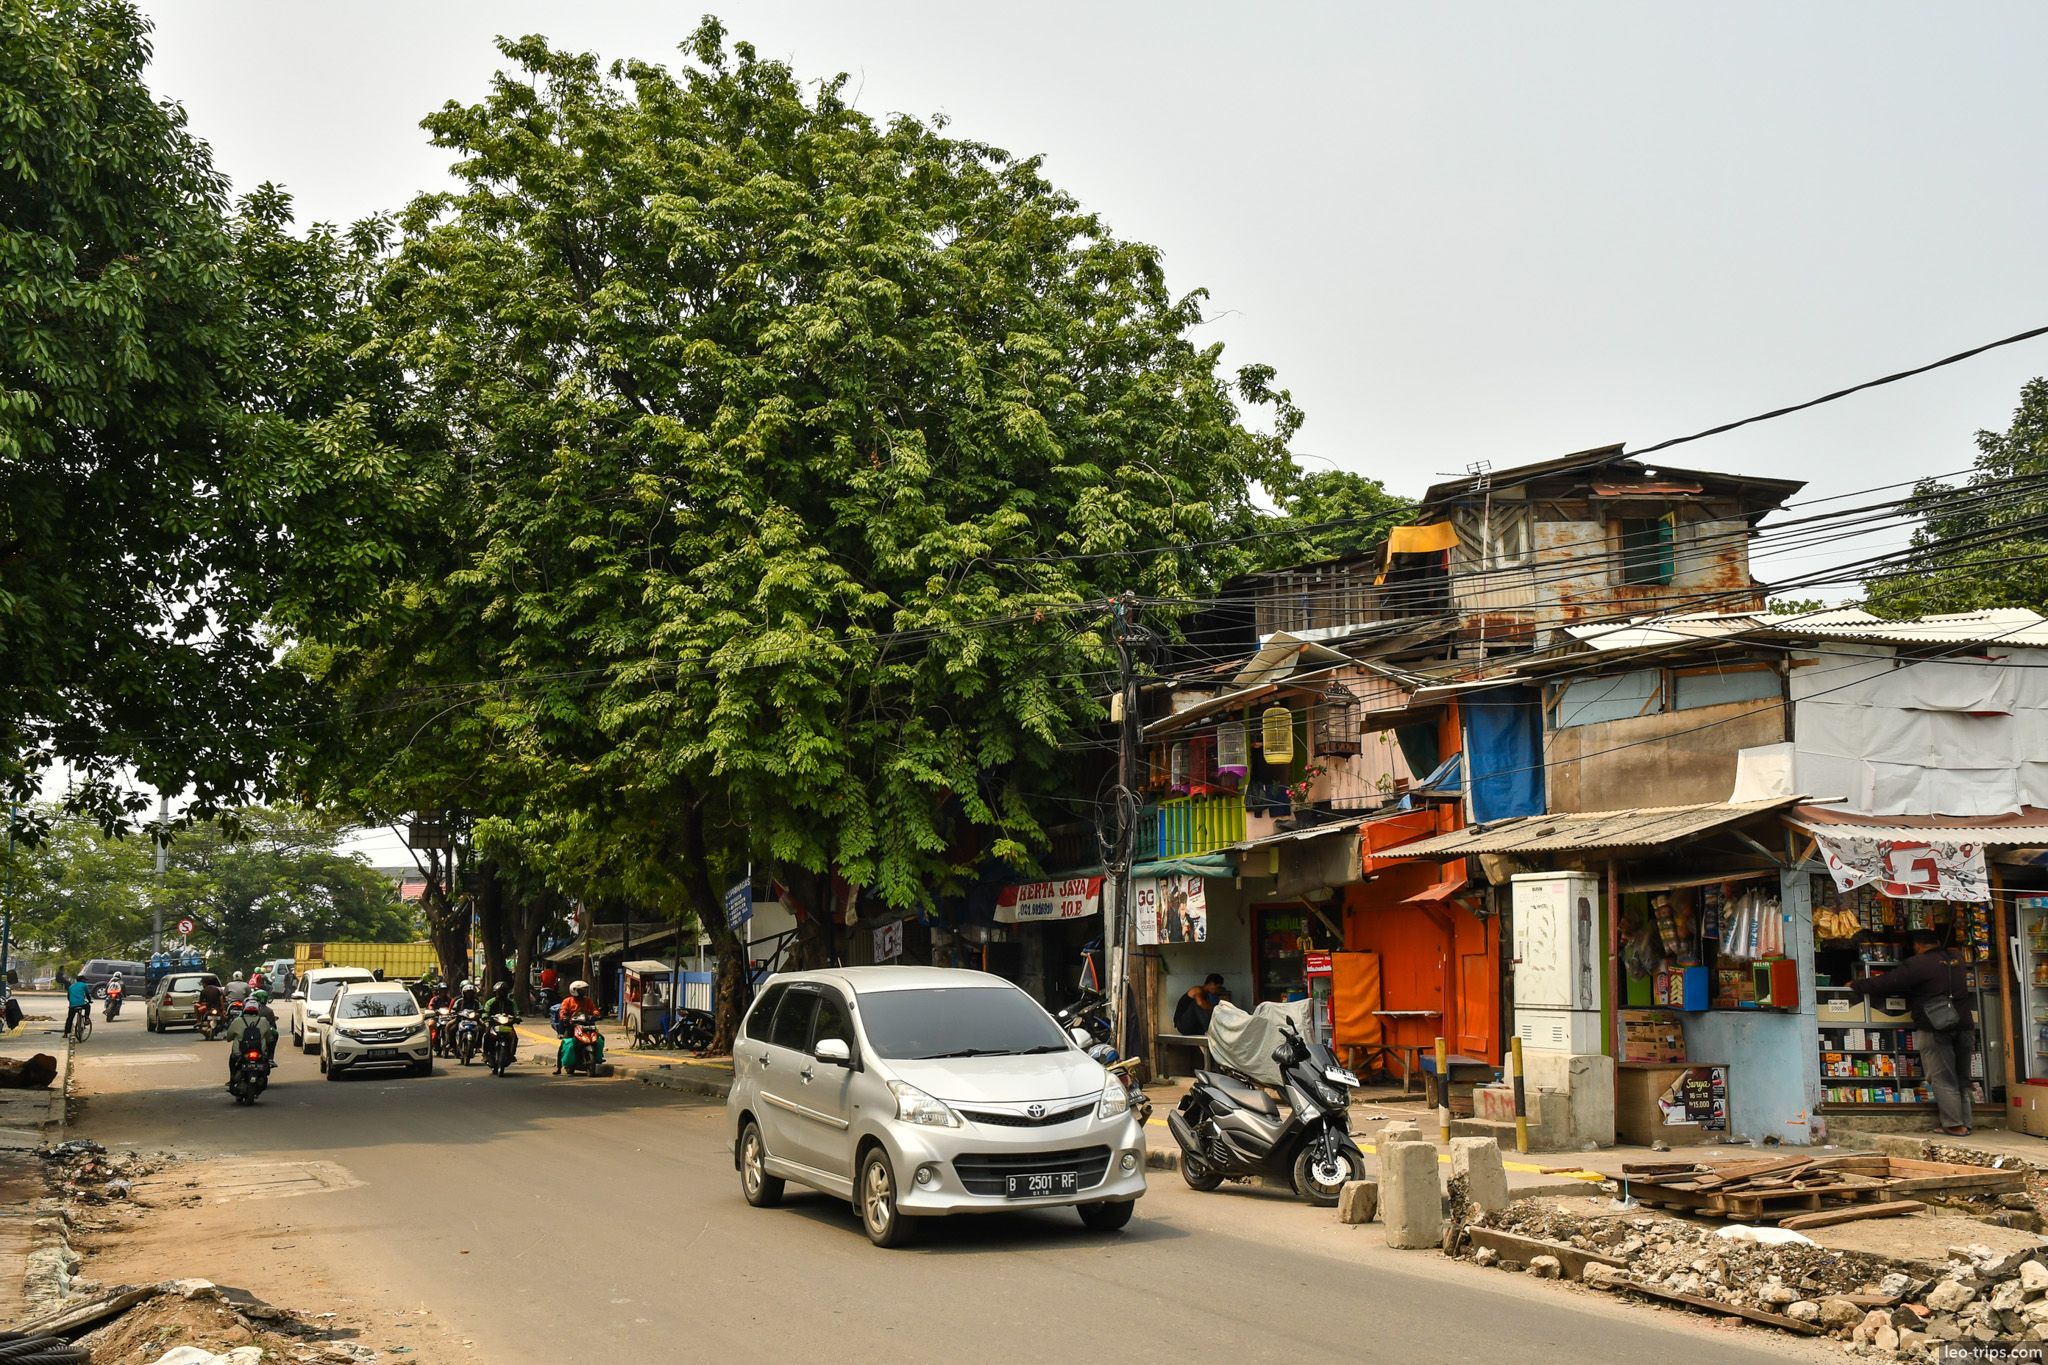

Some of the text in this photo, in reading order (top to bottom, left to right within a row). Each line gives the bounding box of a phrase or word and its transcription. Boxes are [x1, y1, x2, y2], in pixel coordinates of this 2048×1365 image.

[1019, 879, 1086, 901] KERTA JAYA
[1138, 889, 1154, 906] GG
[1686, 1079, 1710, 1092] Surya
[1009, 1174, 1075, 1192] B 2501 RF
